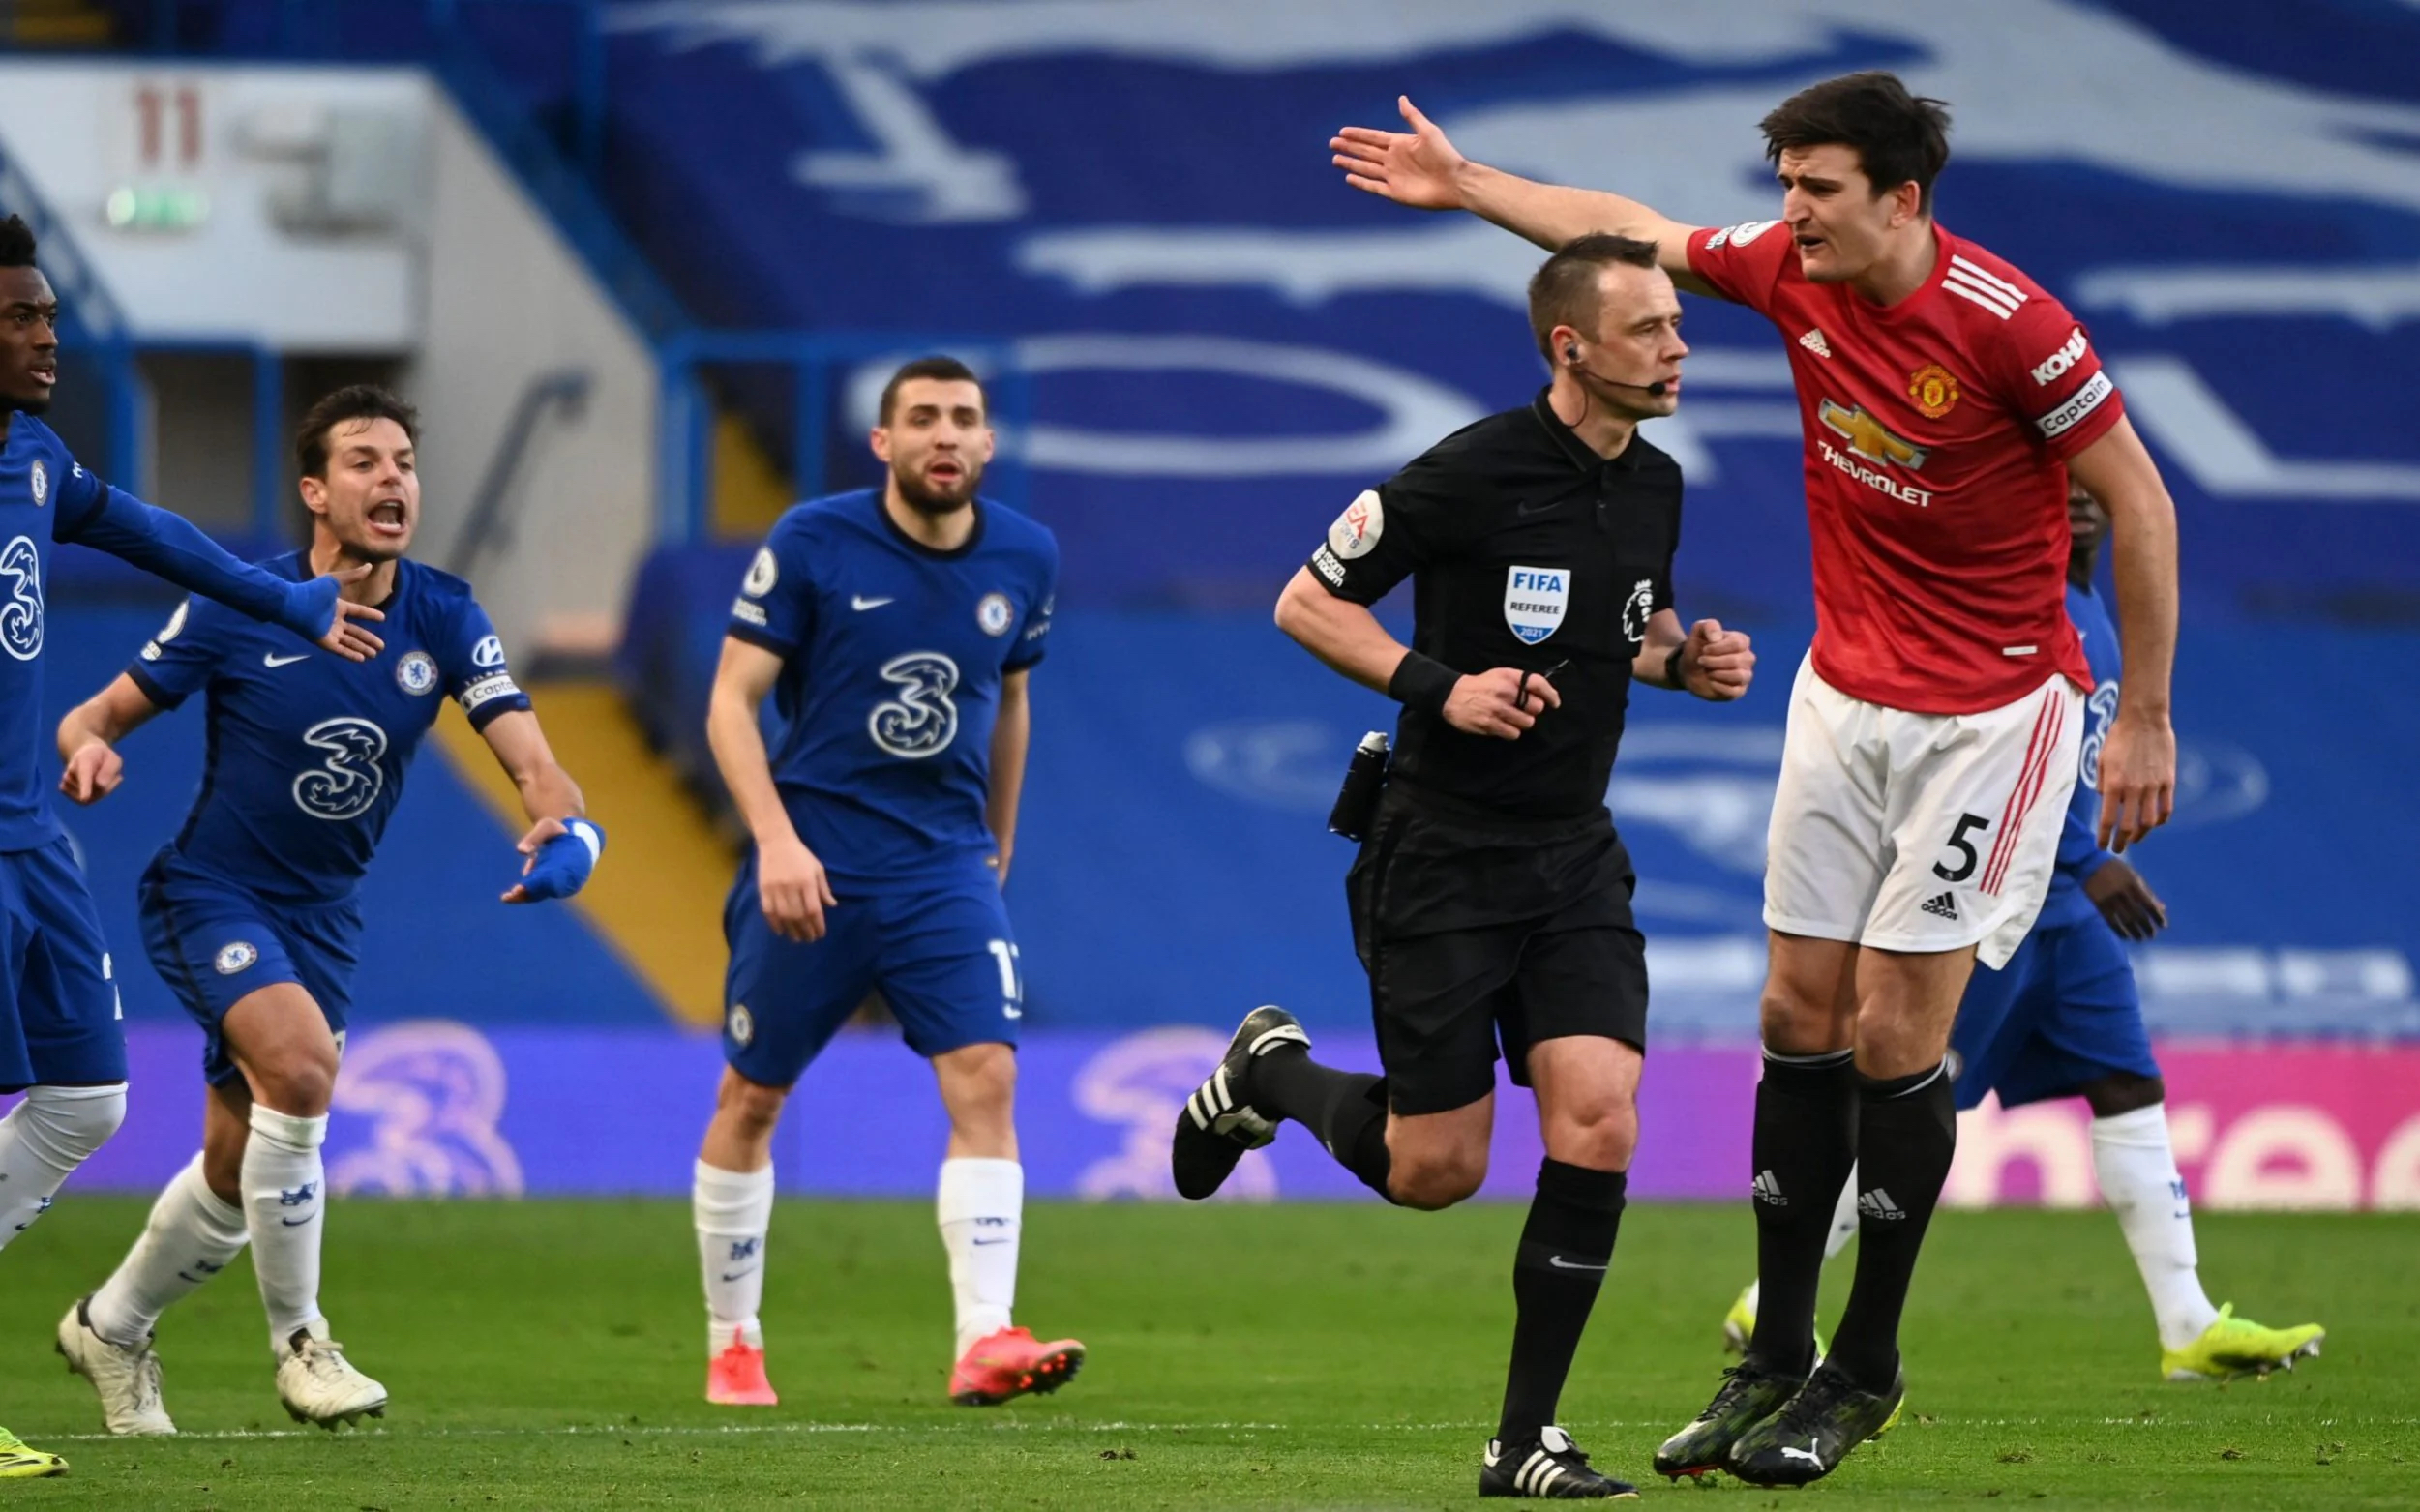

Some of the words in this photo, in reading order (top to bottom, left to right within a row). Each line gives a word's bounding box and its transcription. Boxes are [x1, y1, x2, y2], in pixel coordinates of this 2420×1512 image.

[134, 85, 203, 166] 11
[2043, 380, 2106, 431] Captain
[1513, 572, 1562, 593] FIFA
[1509, 601, 1561, 615] REFEREE
[1931, 812, 1990, 883] 5
[1920, 903, 1958, 921] adidas
